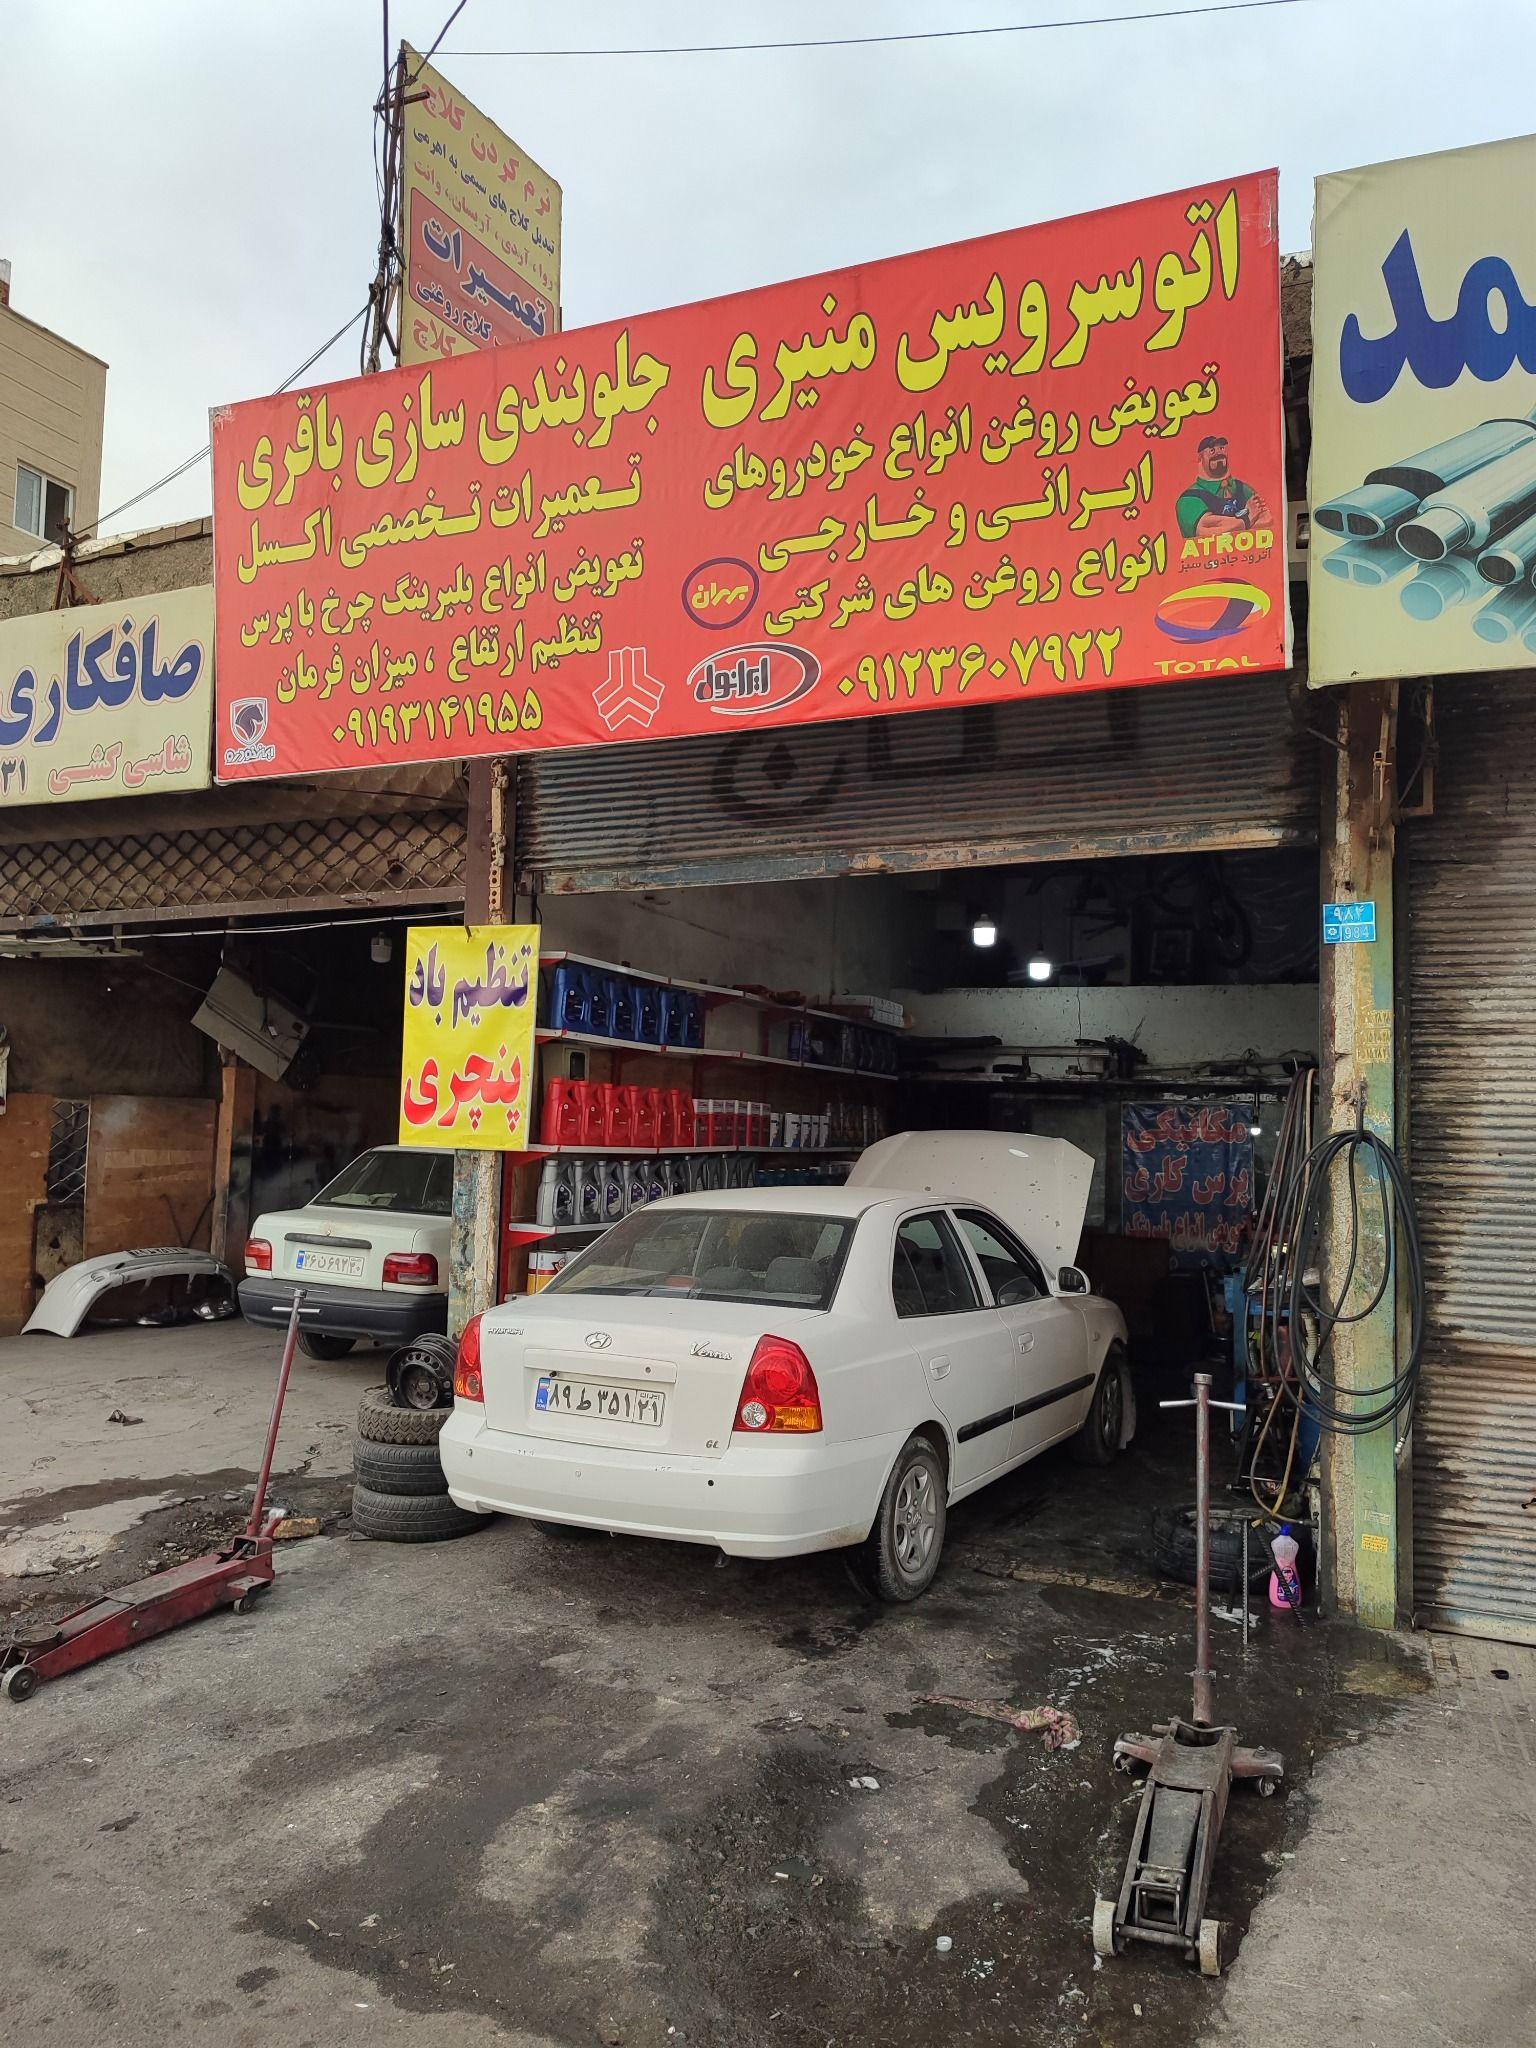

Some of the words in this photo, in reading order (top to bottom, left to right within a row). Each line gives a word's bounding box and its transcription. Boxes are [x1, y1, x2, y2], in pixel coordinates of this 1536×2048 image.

[422, 217, 546, 337] تعمیرات
[462, 311, 492, 341] کلاچ
[701, 293, 878, 428] منیری
[478, 328, 671, 464] جلوبندی
[1089, 361, 1221, 447] تعویض
[237, 393, 344, 511] باقری
[355, 371, 465, 488] سازی
[883, 403, 972, 478] انواع
[981, 395, 1079, 464] روغن
[490, 453, 642, 539] تعمیرات
[703, 423, 875, 510] خودروهای
[975, 451, 1153, 542] ایرانی
[237, 506, 332, 584] اکسل
[339, 480, 482, 569] تخصصی
[758, 487, 936, 573] خارجی
[945, 501, 968, 547] و
[1180, 529, 1274, 559] ATROD
[381, 563, 473, 622] بلبرینگ
[481, 546, 546, 619] انواع
[553, 537, 645, 603] تعویض
[883, 562, 954, 621] های
[963, 554, 1061, 606] روغن
[1070, 532, 1168, 599] انواع
[1178, 558, 1201, 574] سبز
[240, 599, 293, 648] پرس
[320, 587, 375, 636] چرخ
[763, 574, 872, 638] شرکتی
[350, 639, 418, 696] میزان
[447, 619, 525, 684] ارتفاع
[531, 610, 603, 673] تنظیم
[836, 626, 1122, 703] ۰۹۱۲۳۶۰۷۹۲۲
[1154, 655, 1261, 676] TOTAL
[0, 616, 203, 747] صافکاری
[276, 644, 345, 703] فرمان
[694, 654, 771, 702] ایرانول
[331, 687, 544, 749] ۰۹۱۹۳۱۴۱۹۵۵
[48, 741, 123, 796] کشی
[122, 734, 193, 789] شاسی
[1333, 904, 1366, 922] ۹۸۴
[1344, 926, 1370, 940] 984
[409, 941, 446, 1027] باد
[452, 941, 532, 1030] تنظیم
[403, 1043, 522, 1134] پنچری
[1127, 1107, 1248, 1152] مکانیکی
[1125, 1154, 1188, 1203] کاری
[1192, 1168, 1249, 1208] پرس
[689, 1340, 733, 1361] Verna
[705, 1439, 720, 1449] GL
